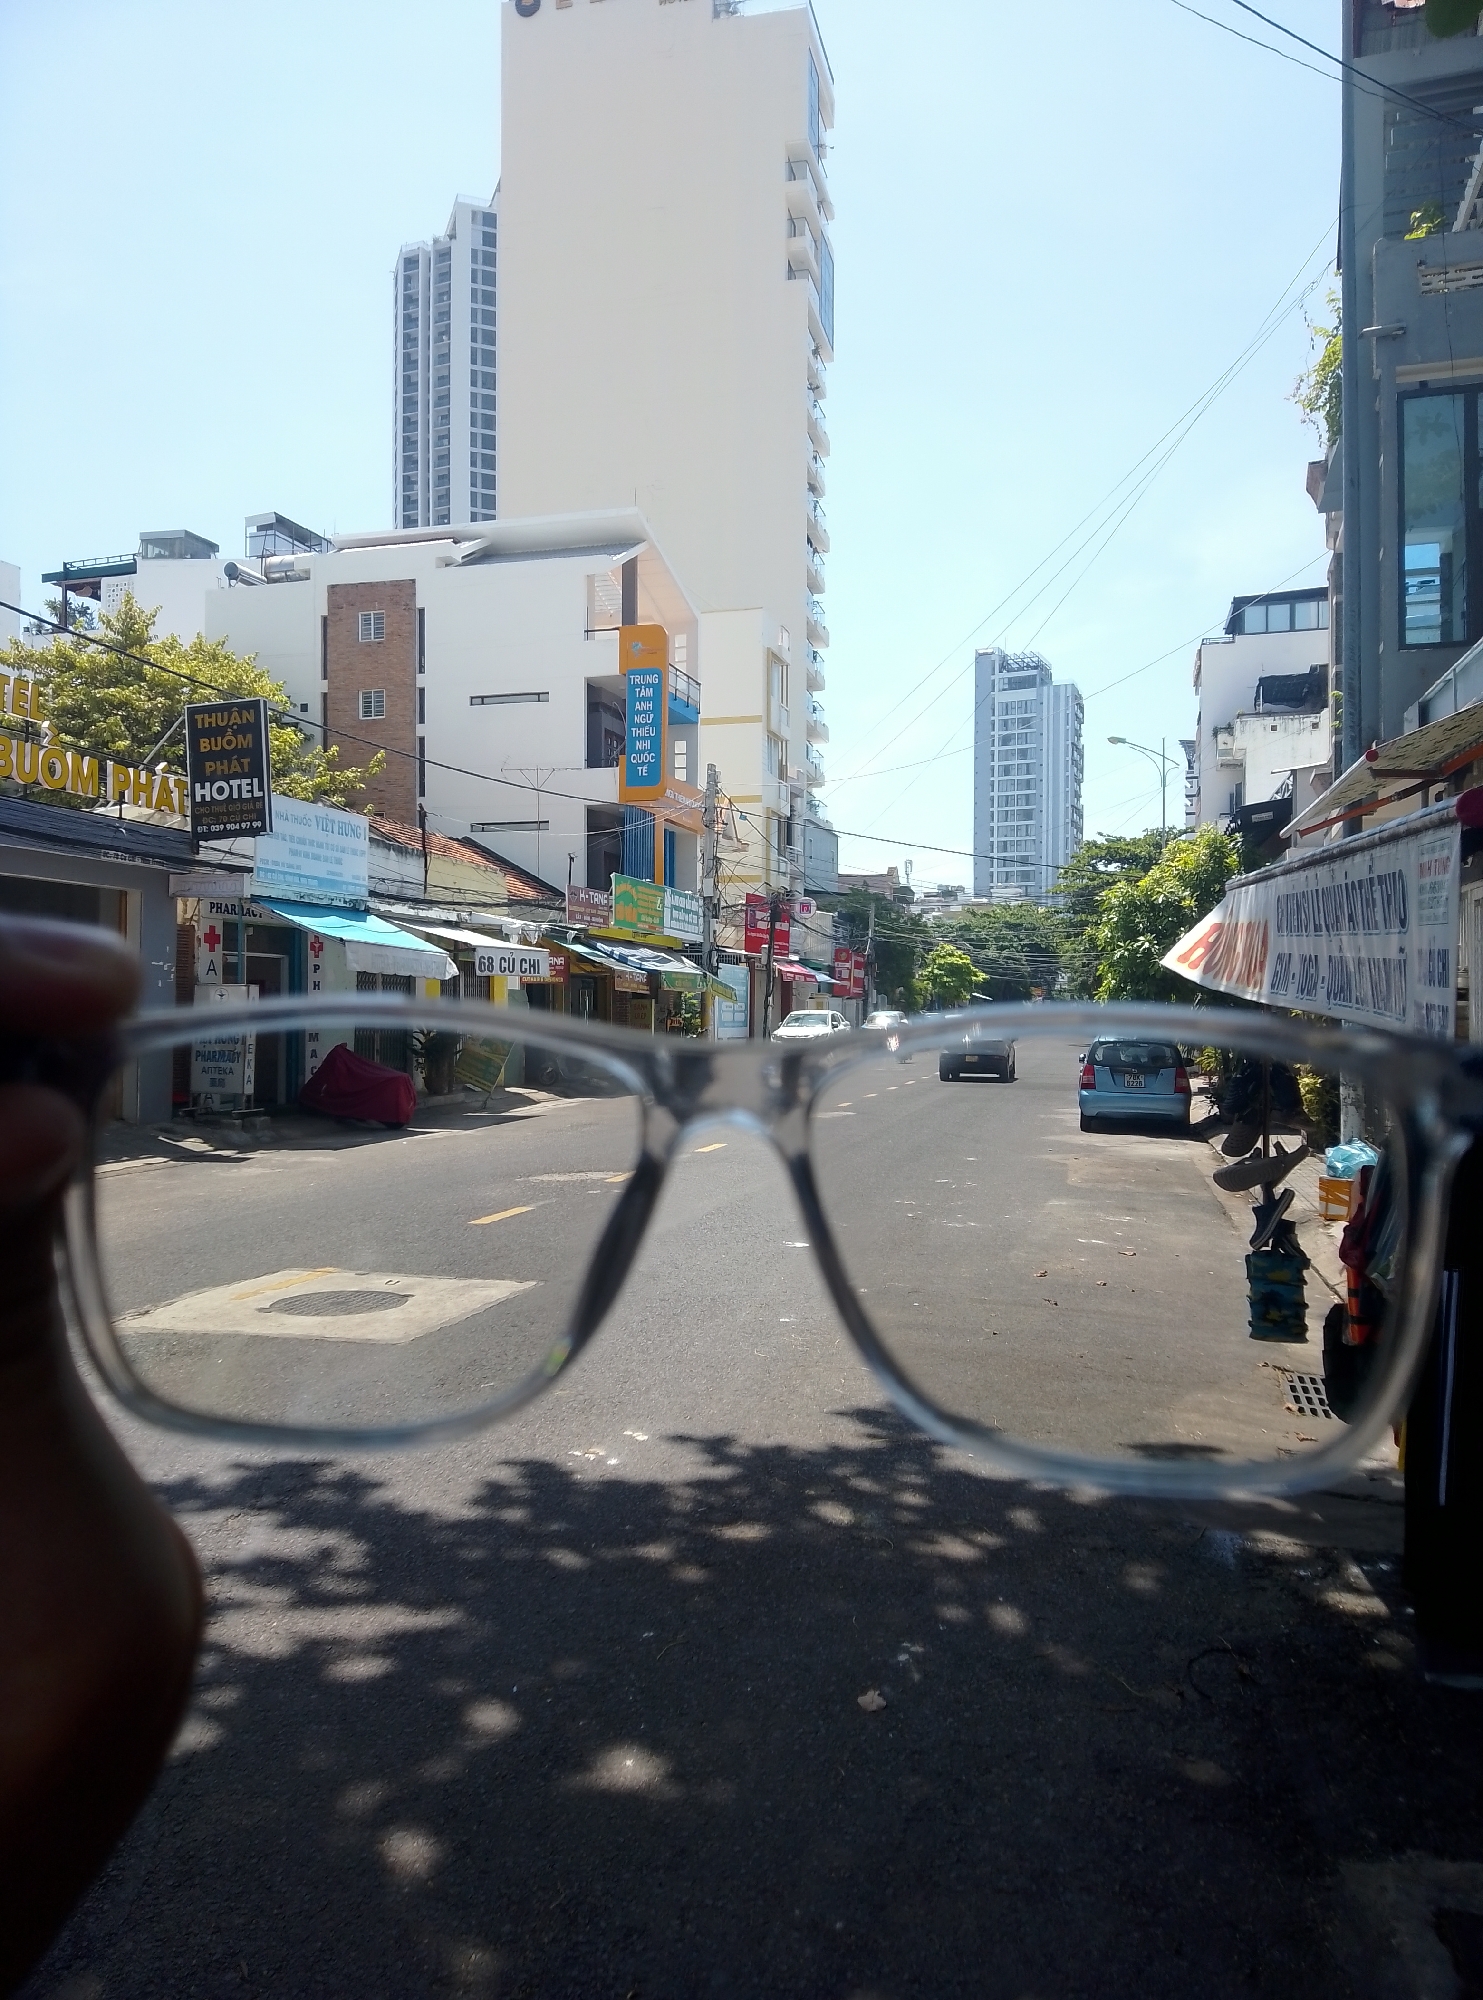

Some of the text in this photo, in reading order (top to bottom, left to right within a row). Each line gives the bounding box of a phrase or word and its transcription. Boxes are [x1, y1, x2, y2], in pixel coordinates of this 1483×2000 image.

[629, 674, 659, 685] TRUNG
[0, 672, 45, 723] TEL
[635, 685, 653, 697] TÂM
[634, 700, 653, 711] ANH
[194, 707, 255, 729] THUẬN
[634, 711, 654, 724] NGỮ
[631, 725, 656, 737] THIẾU
[199, 728, 253, 752] BUỒM
[635, 739, 651, 750] NHI
[630, 750, 656, 764] QUỐC
[0, 721, 189, 815] BUỒM PHÁT
[204, 755, 251, 777] PHÁT
[636, 764, 649, 776] TẾ
[194, 777, 264, 803] HOTEL
[242, 812, 257, 821] CHI
[275, 809, 290, 822] NHÀ
[210, 823, 224, 832] 039
[226, 822, 240, 831] 904
[241, 821, 250, 830] 97
[209, 902, 263, 918] PHARMAC
[478, 952, 541, 975] 68 CỦ CHI
[1295, 953, 1319, 1000] YOGA
[195, 1050, 242, 1064] PHARMACY
